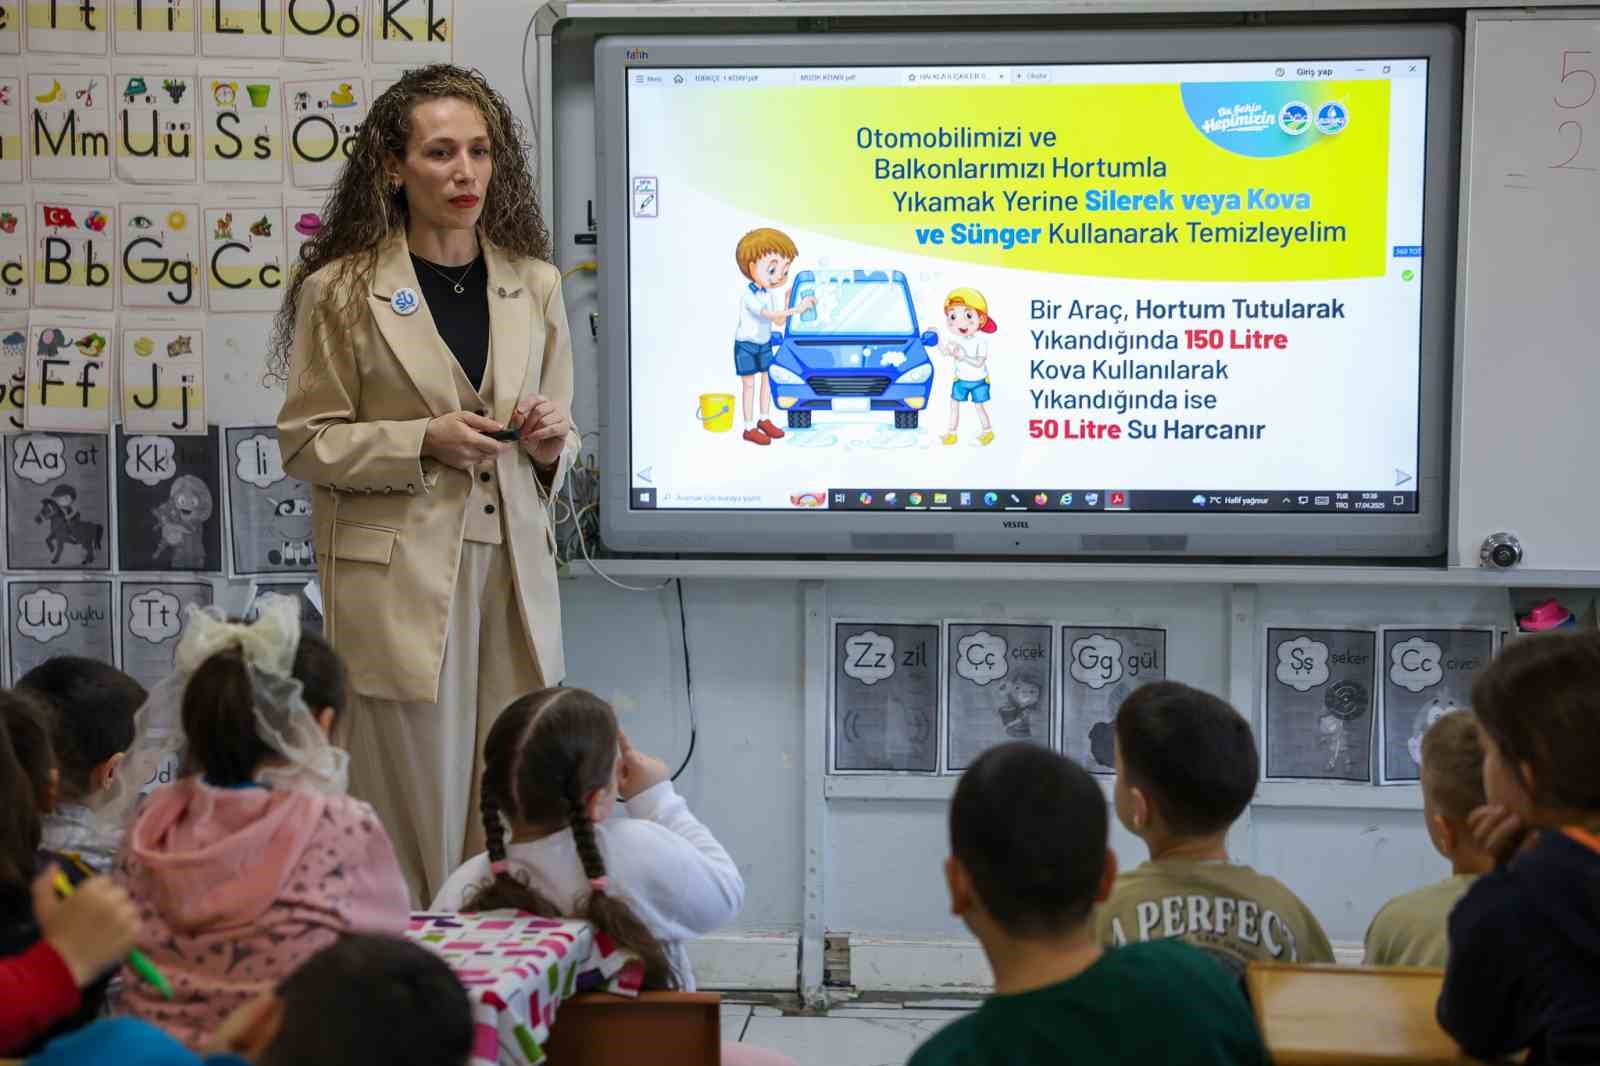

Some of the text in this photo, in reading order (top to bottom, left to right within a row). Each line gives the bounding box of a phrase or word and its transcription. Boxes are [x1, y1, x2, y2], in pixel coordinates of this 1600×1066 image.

[1554, 51, 1597, 109] 5
[33, 108, 108, 157] Mm
[214, 112, 271, 159] Ss
[1202, 110, 1276, 133] Hepimizin
[857, 126, 1057, 149] Otomobilimizi ve
[875, 156, 1167, 180] Balkonlarımızı Hortumla
[893, 188, 1311, 216] Yıkamak Yerine Silerek veya Kova
[915, 221, 1347, 249] ve Sünger Kullanarak Temizleyelim
[44, 237, 109, 286] Bb
[123, 237, 193, 304] Gg
[211, 243, 280, 288] Cc
[1031, 298, 1345, 324] Bir Araç, Hortum Tutularak
[1030, 329, 1288, 354] Yıkandığında 150 Litre
[1030, 360, 1229, 380] Kova Kullanılarak
[41, 360, 99, 409] Ff
[133, 363, 188, 430] Jj
[1030, 389, 1218, 414] Yıkandığında ise
[1029, 419, 1266, 440] 50 Litre Su Harcanır
[20, 441, 99, 470] Aa at
[136, 443, 166, 473] Kk
[1002, 521, 1029, 529] VESTEL
[25, 600, 105, 626] Uu uyku
[140, 599, 170, 627] Tt
[853, 641, 928, 668] Zz zil
[966, 643, 997, 671] Çç
[1078, 646, 1159, 679] Gg gül
[1290, 647, 1314, 675] Şş
[1401, 649, 1433, 672] Cc
